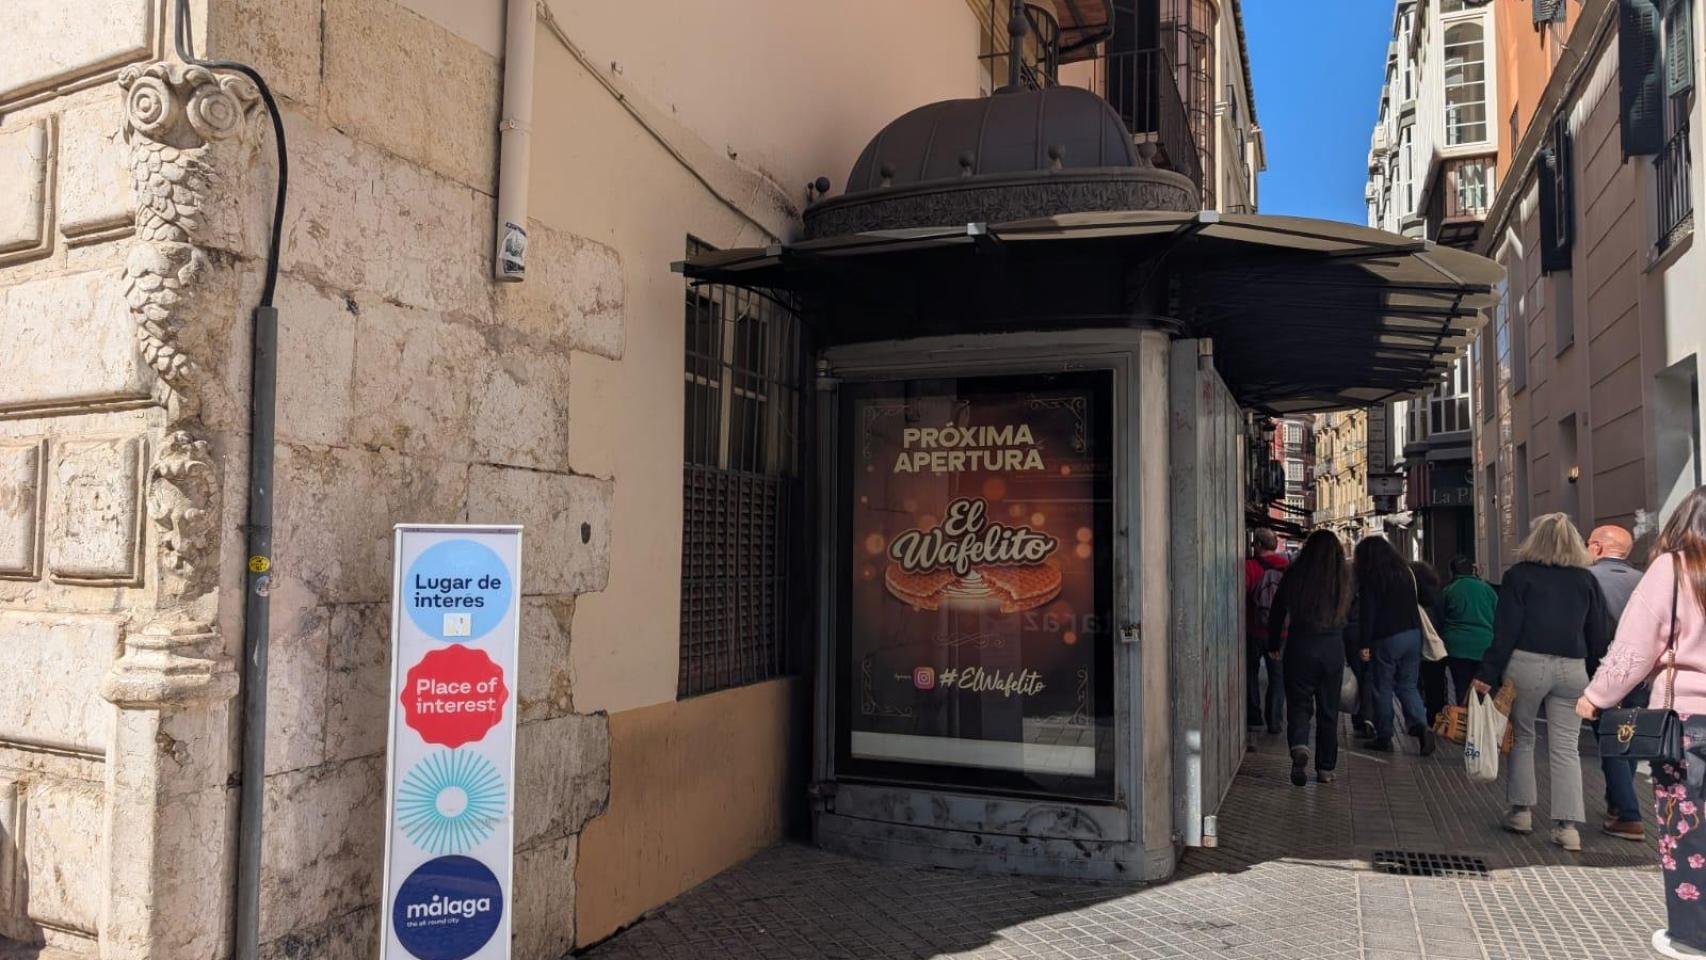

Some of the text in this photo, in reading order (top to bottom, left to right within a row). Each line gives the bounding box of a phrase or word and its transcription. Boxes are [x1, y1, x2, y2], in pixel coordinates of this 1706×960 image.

[903, 422, 1034, 448] PRÓXIMA
[893, 449, 1045, 473] APERTURA
[1432, 488, 1450, 504] La
[945, 500, 985, 535] El
[893, 526, 1055, 574] Wafelito
[415, 573, 502, 593] Lugar de
[414, 591, 485, 608] interés
[416, 677, 498, 695] Place of
[416, 696, 496, 714] interest
